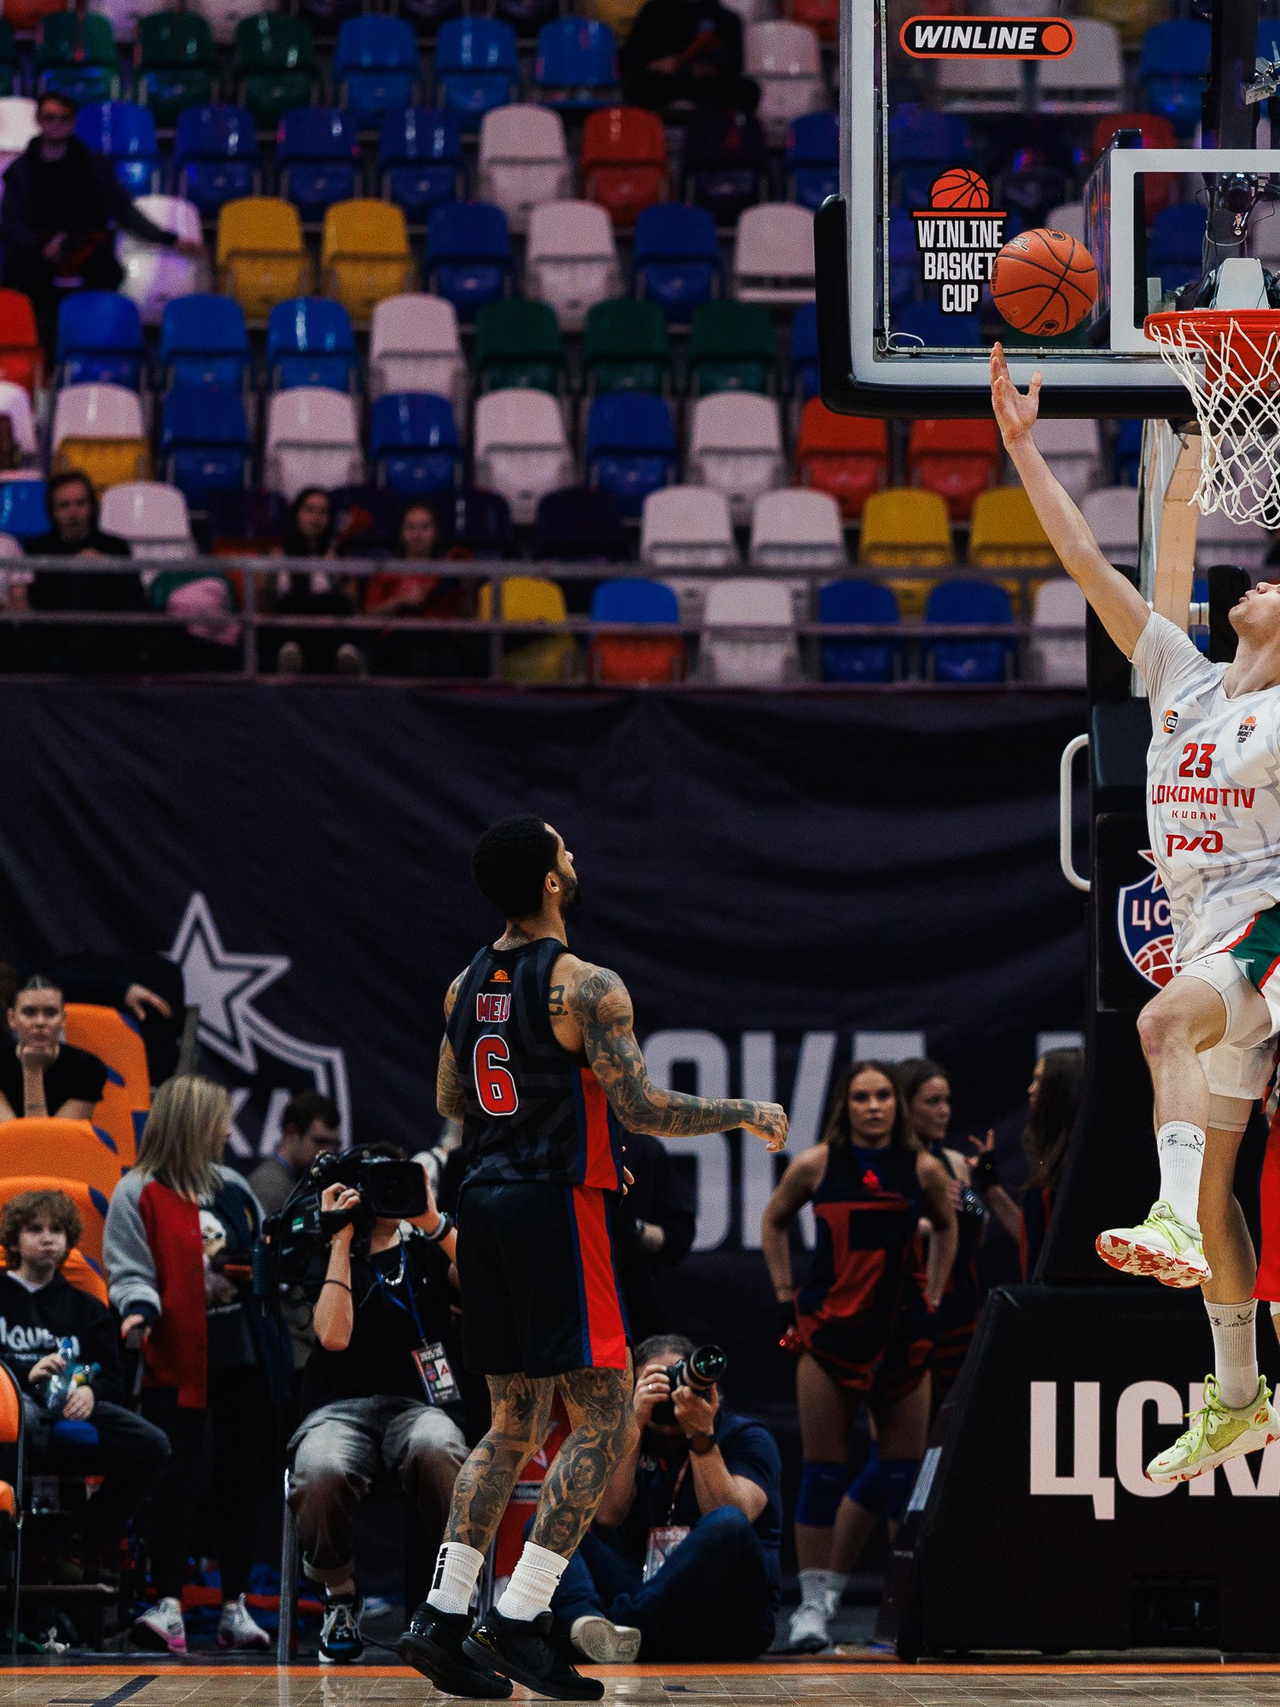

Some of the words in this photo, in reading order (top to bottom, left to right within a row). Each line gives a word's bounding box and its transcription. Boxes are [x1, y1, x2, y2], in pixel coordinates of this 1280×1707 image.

[915, 25, 1037, 50] WINLINE
[918, 220, 1003, 248] WINLINE
[924, 252, 996, 280] BASKET
[942, 284, 979, 312] CUP
[1179, 742, 1217, 778] 23
[1152, 784, 1256, 809] LOKOMOTIV
[1171, 810, 1217, 820] KUBAN
[473, 1034, 519, 1116] 6
